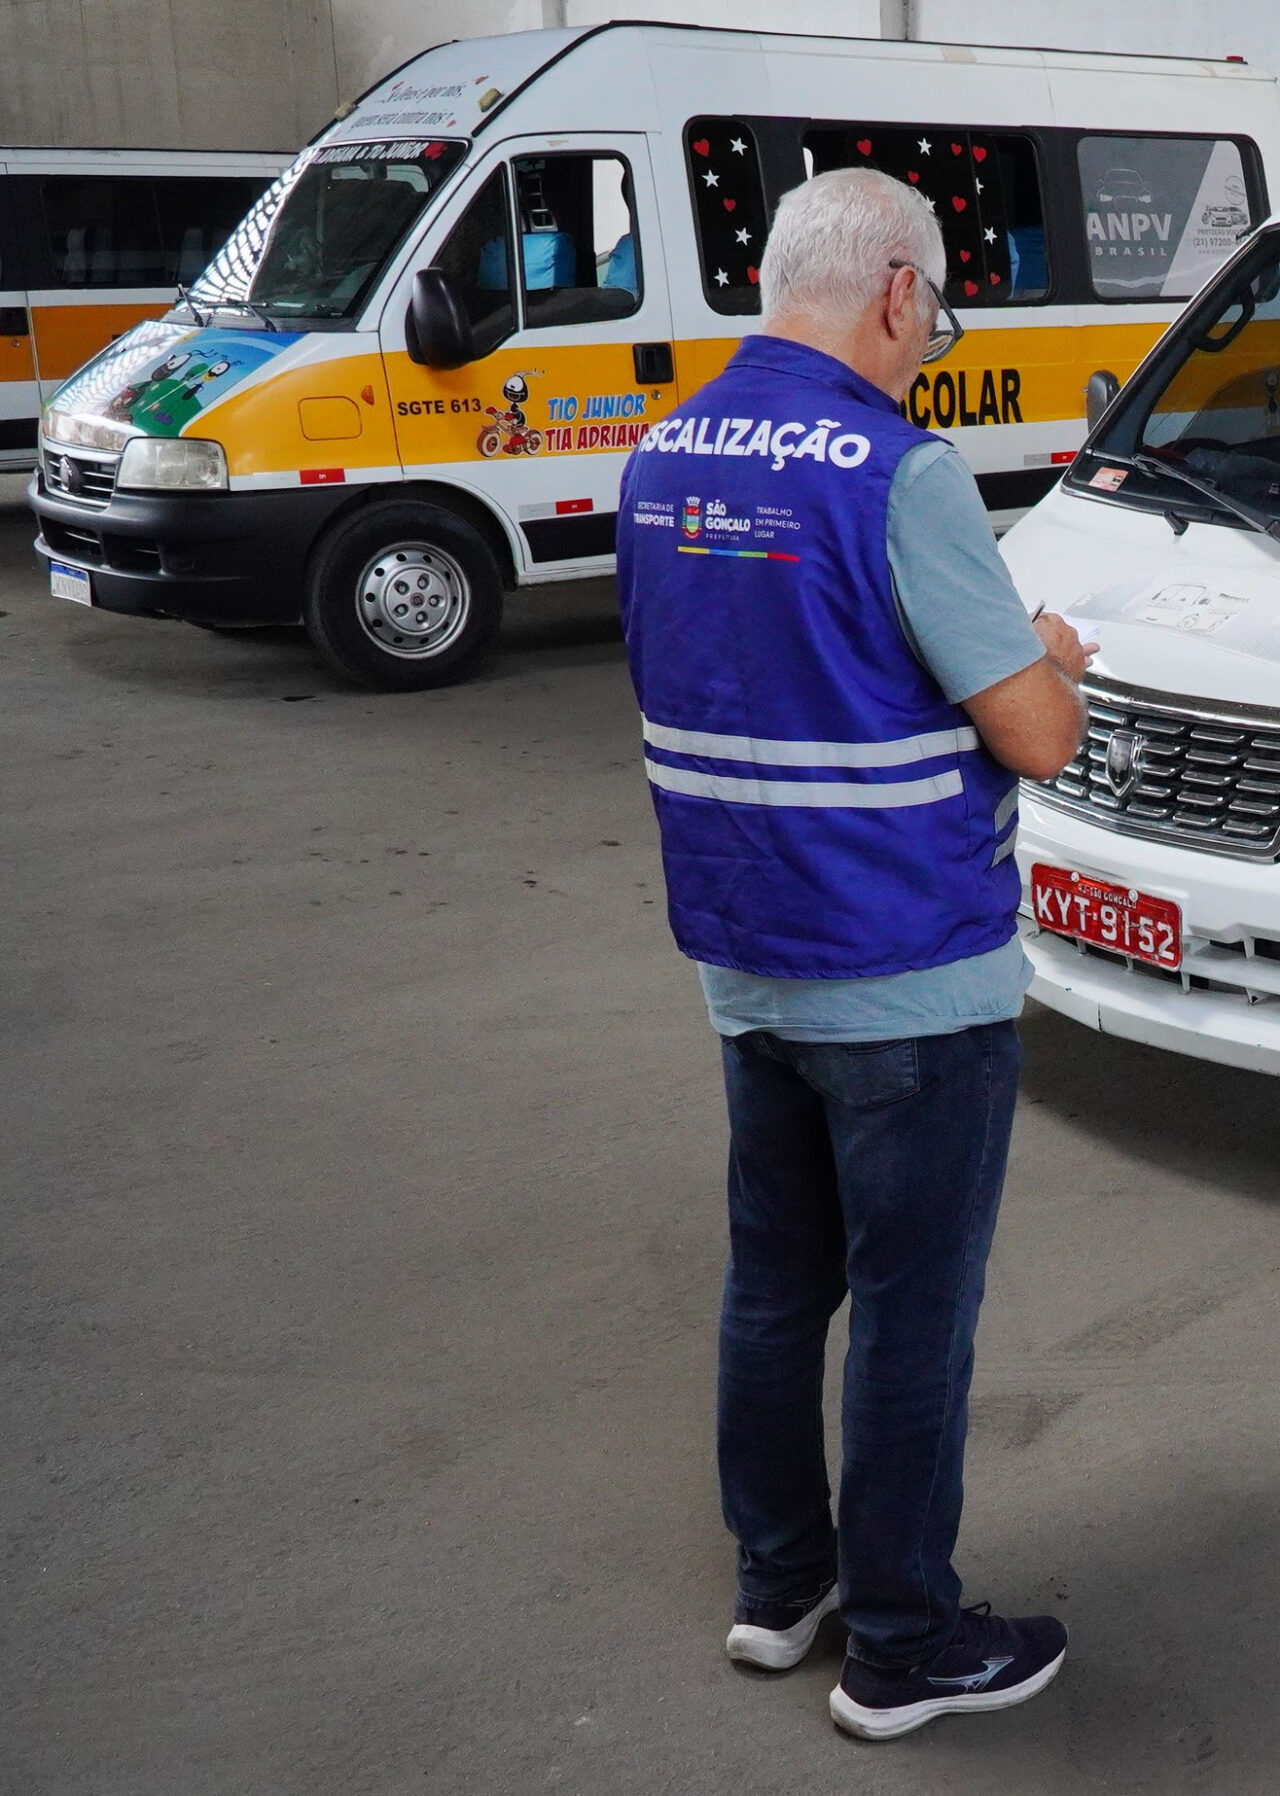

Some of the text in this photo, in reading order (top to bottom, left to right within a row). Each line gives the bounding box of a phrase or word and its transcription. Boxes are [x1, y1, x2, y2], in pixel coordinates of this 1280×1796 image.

[1087, 213, 1172, 241] ANPV
[1095, 247, 1167, 256] BRASIL
[397, 398, 482, 416] SGTE 613
[547, 393, 646, 421] TIO JUNIOR
[901, 369, 1024, 430] COLAR
[544, 427, 573, 452] TIA
[637, 501, 674, 512] SECRETARIA DE
[706, 499, 727, 516] SÃO
[757, 506, 793, 517] TRABALHO
[705, 516, 751, 532] GONÇALO
[764, 519, 801, 530] PRIMEIRO
[754, 530, 776, 539] LUGAR
